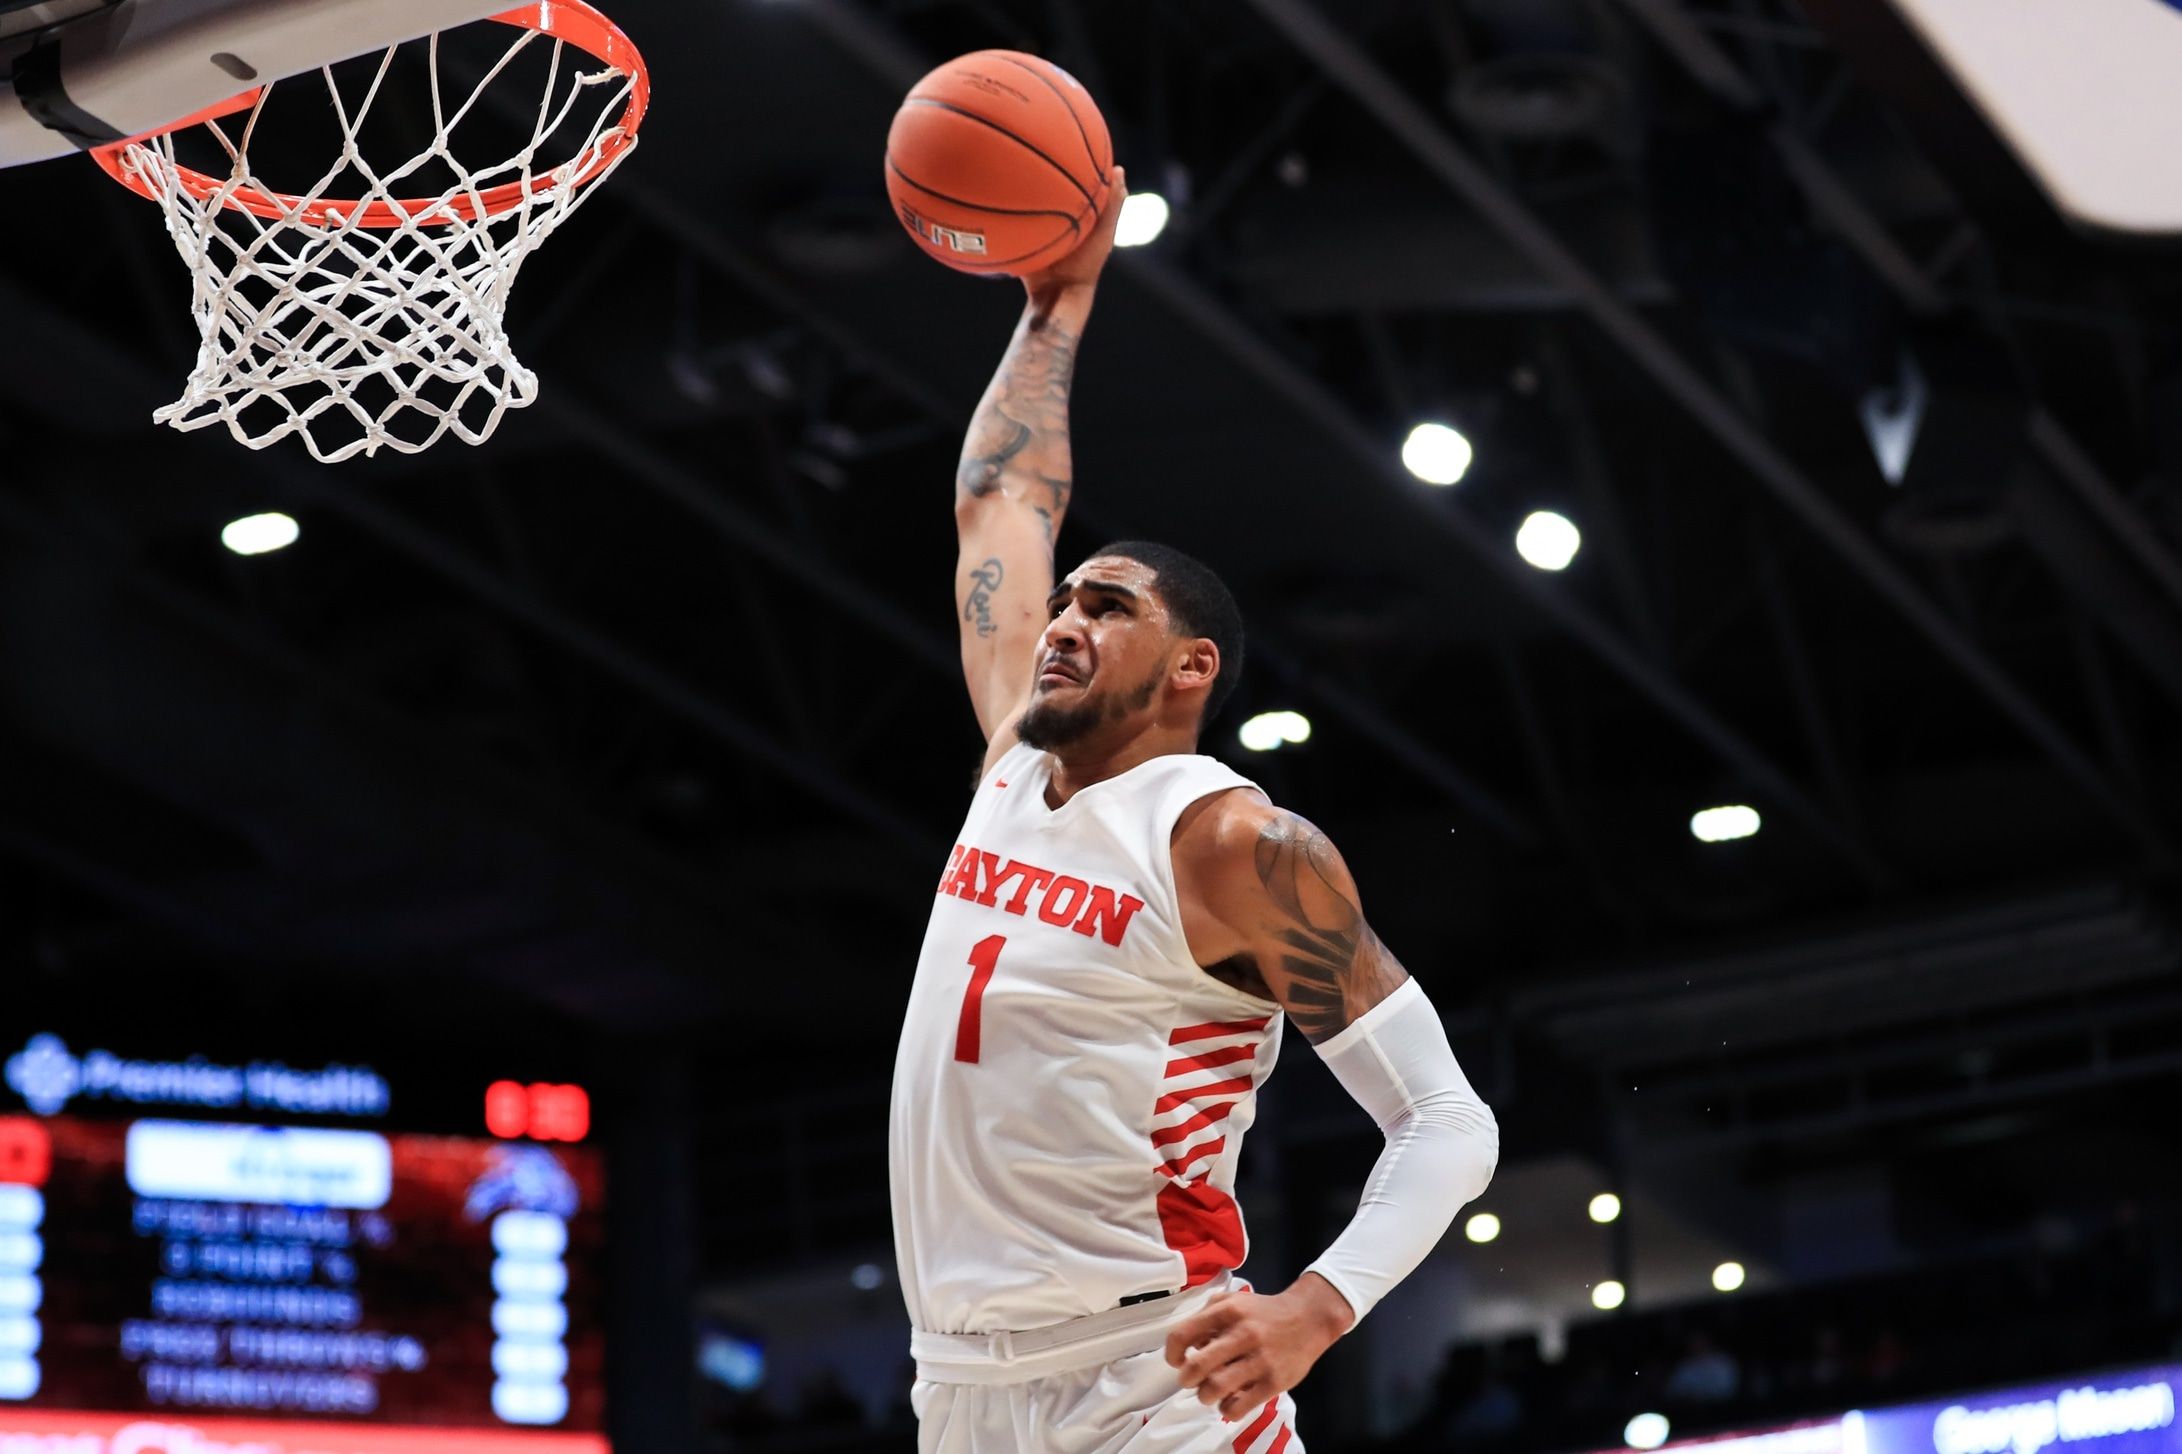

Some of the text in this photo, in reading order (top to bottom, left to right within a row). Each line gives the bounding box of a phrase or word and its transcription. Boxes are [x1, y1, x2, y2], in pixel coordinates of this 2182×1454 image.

[953, 934, 1007, 1064] 1
[82, 1051, 389, 1113] Premier Health
